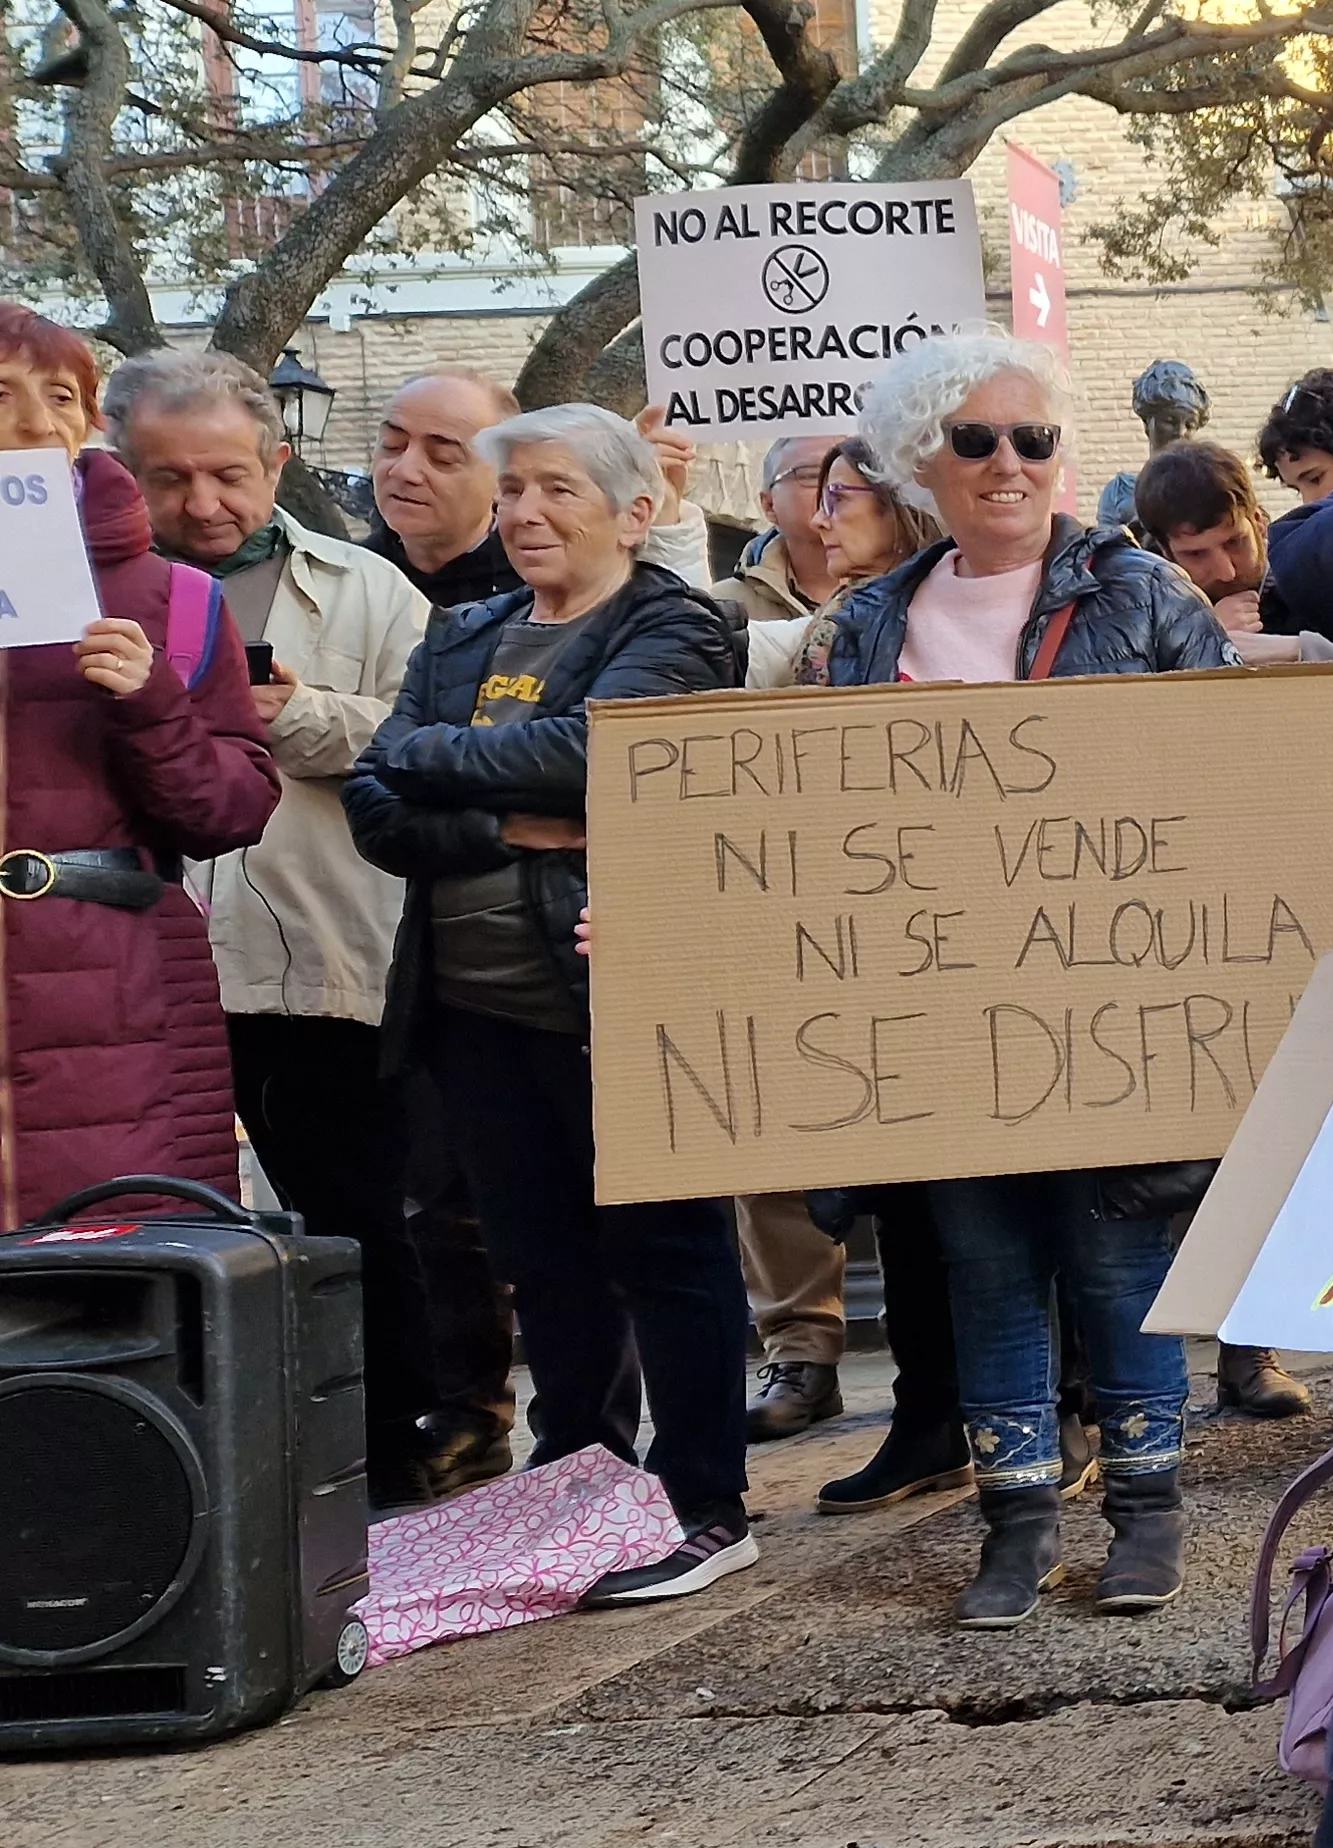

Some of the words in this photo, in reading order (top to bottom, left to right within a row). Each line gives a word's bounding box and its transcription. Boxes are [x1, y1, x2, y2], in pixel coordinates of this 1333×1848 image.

[653, 208, 707, 246] NO
[714, 202, 760, 240] AL
[769, 198, 956, 236] RECORTE
[1010, 202, 1060, 269] VISITA
[660, 311, 960, 369] COOPERACIÓ
[664, 390, 711, 427] AL
[629, 715, 1058, 803] PERIFERIAS
[714, 829, 797, 897] NI
[842, 821, 939, 897] SE
[995, 814, 1189, 888] VENDE
[795, 914, 859, 982] NI
[898, 909, 978, 977] SE
[1015, 892, 1318, 972] ALQUILA
[655, 1009, 763, 1154] NI
[787, 1010, 935, 1133] SE
